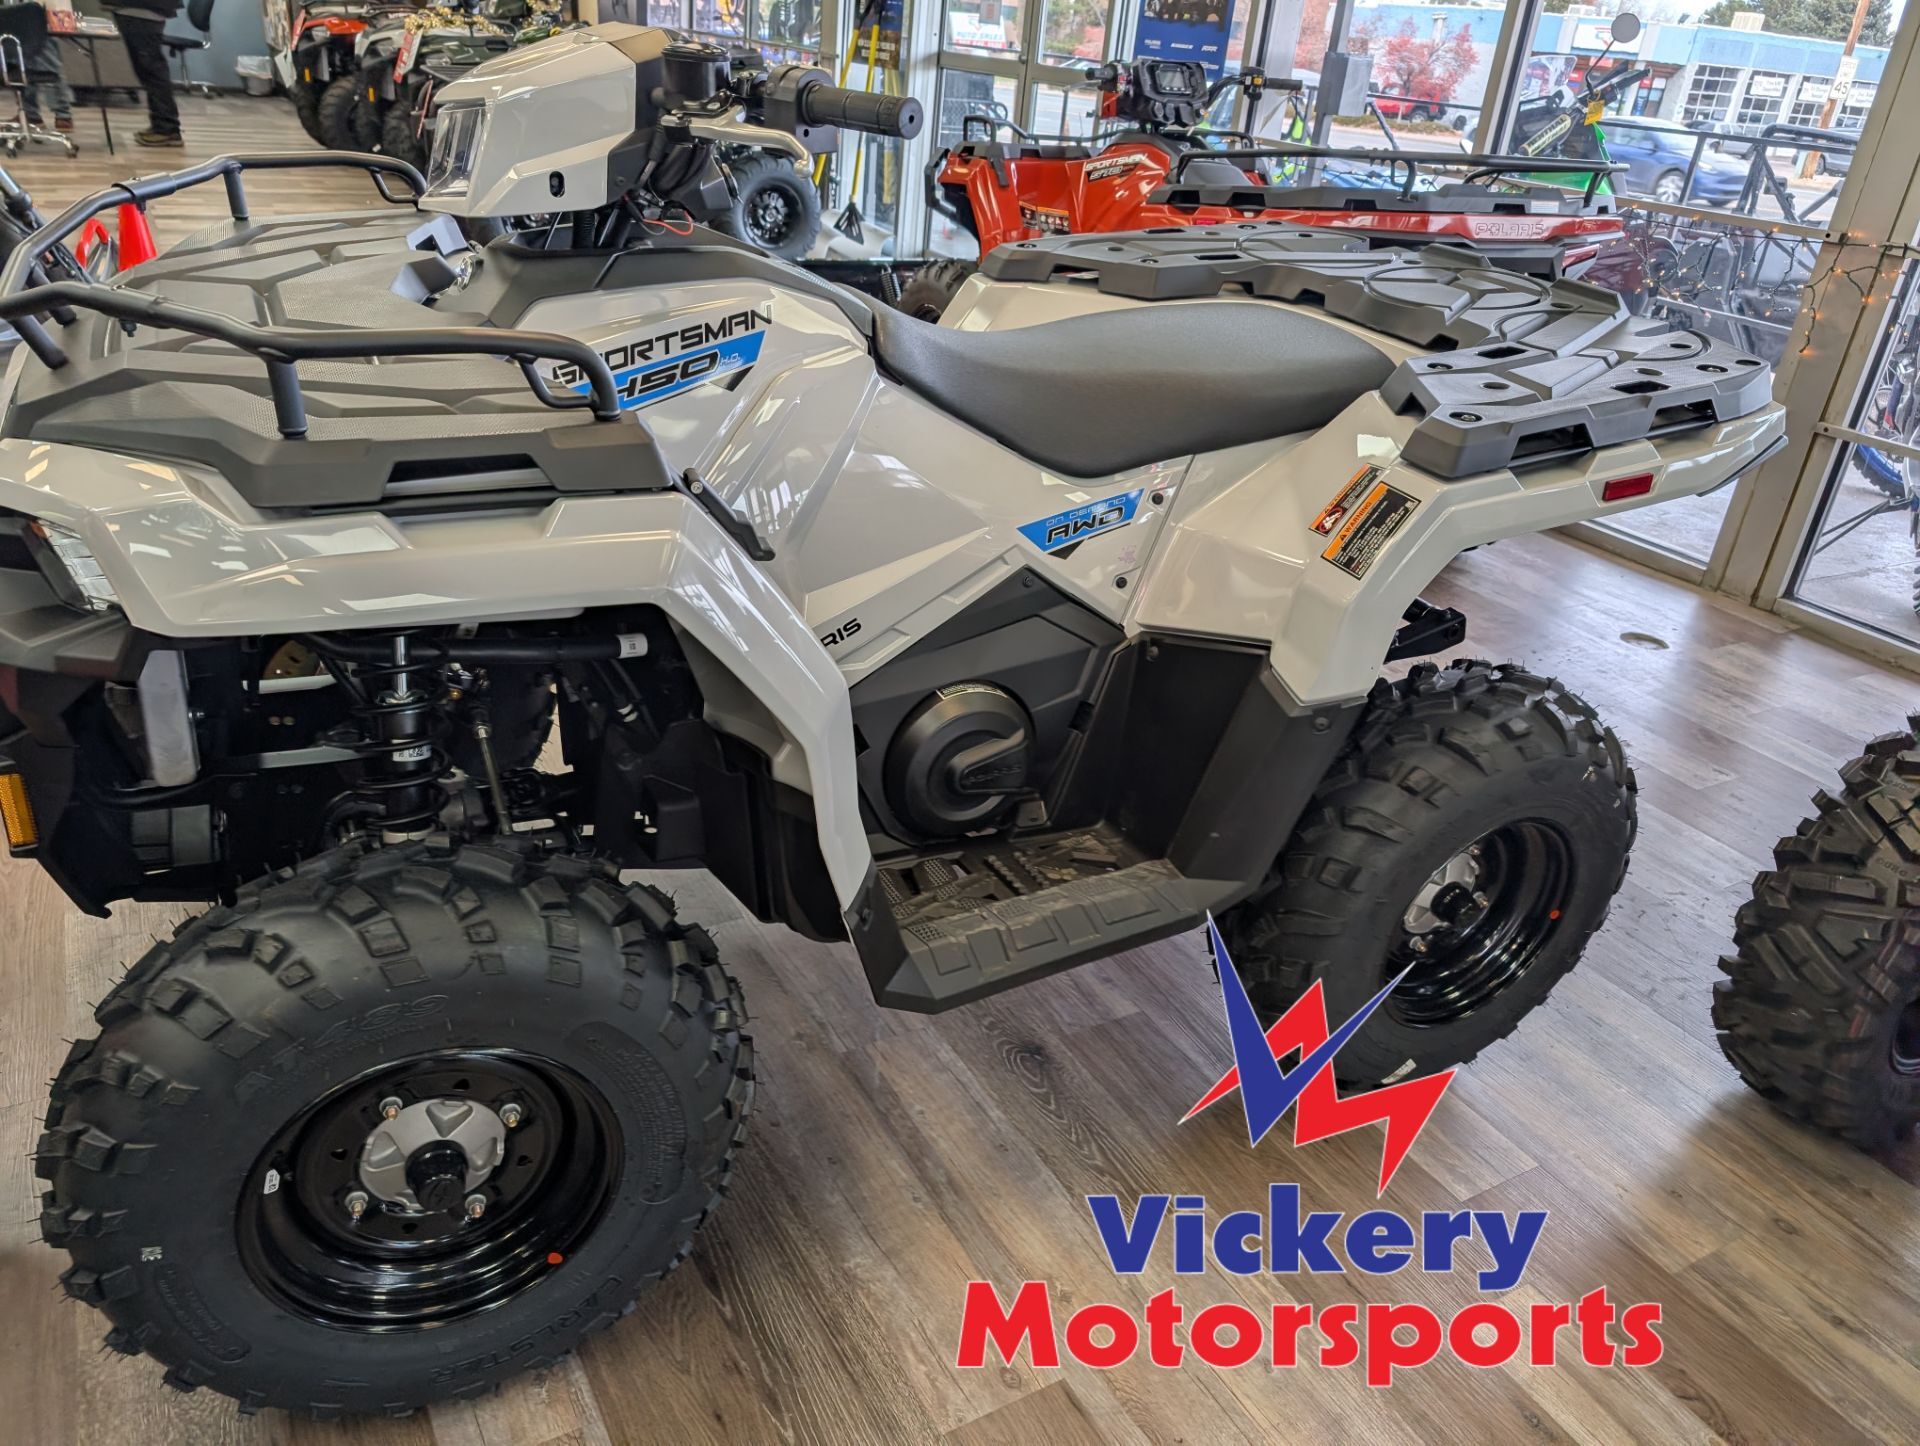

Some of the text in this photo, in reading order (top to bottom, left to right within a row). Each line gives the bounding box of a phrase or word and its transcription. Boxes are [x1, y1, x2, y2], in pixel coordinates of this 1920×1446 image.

[1834, 81, 1850, 95] 45
[1084, 153, 1148, 171] SPORTSMAN
[1474, 221, 1545, 238] POLARIS
[1046, 506, 1124, 545] AWD
[1344, 501, 1373, 534] WARNING
